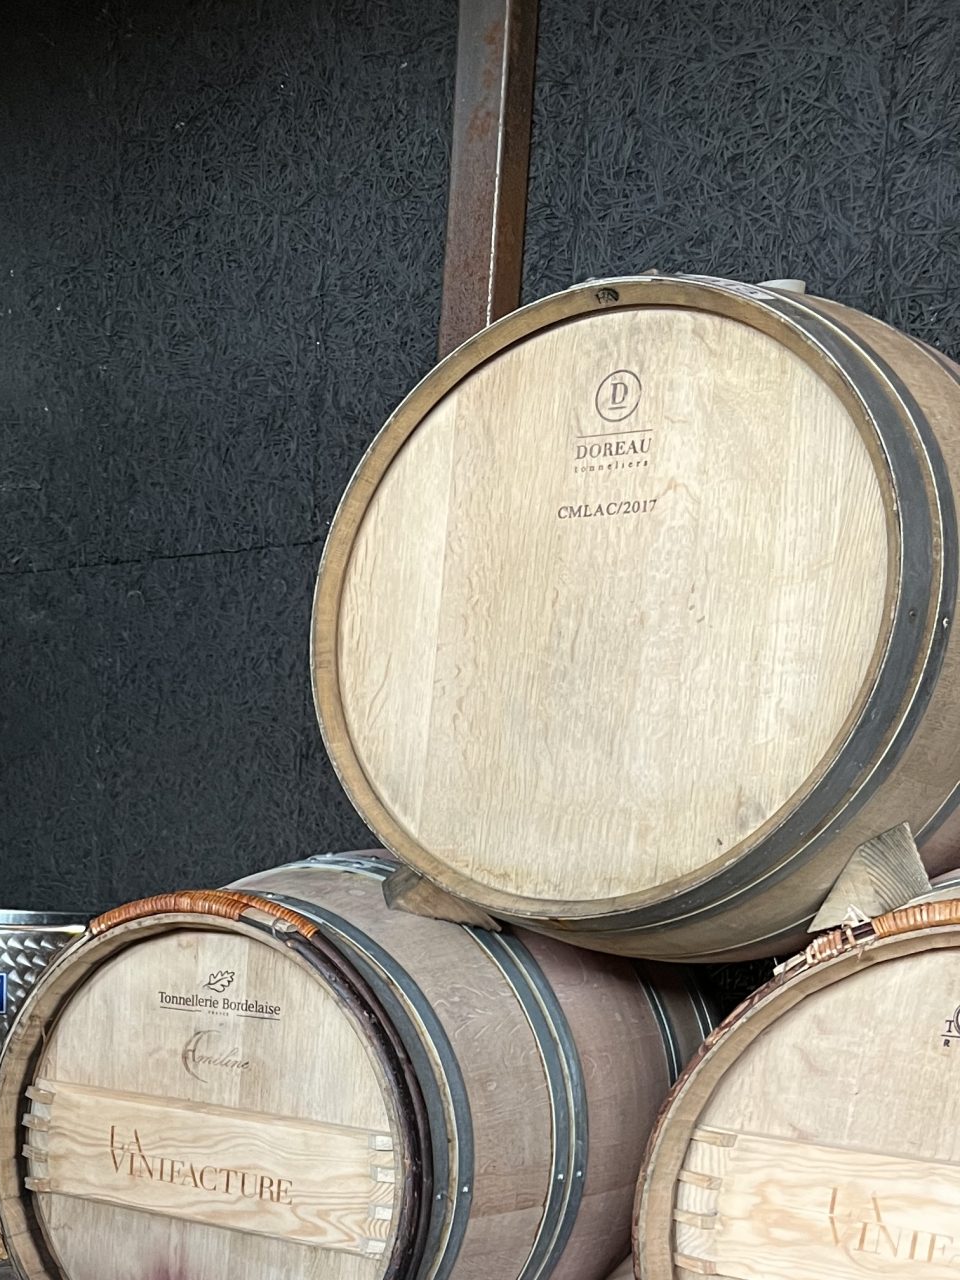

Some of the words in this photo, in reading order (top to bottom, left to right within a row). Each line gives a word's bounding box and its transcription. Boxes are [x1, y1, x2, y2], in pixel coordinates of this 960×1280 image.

[611, 382, 628, 405] D
[576, 438, 652, 460] DOREAU
[574, 460, 648, 474] tonneliers
[558, 499, 657, 520] CMLAC/2017
[158, 991, 219, 1009] Tonnellerie
[222, 998, 281, 1016] Bordelaise
[110, 1125, 142, 1153] LA
[110, 1149, 293, 1206] VINIFACTURE
[828, 1215, 960, 1264] VINIF
